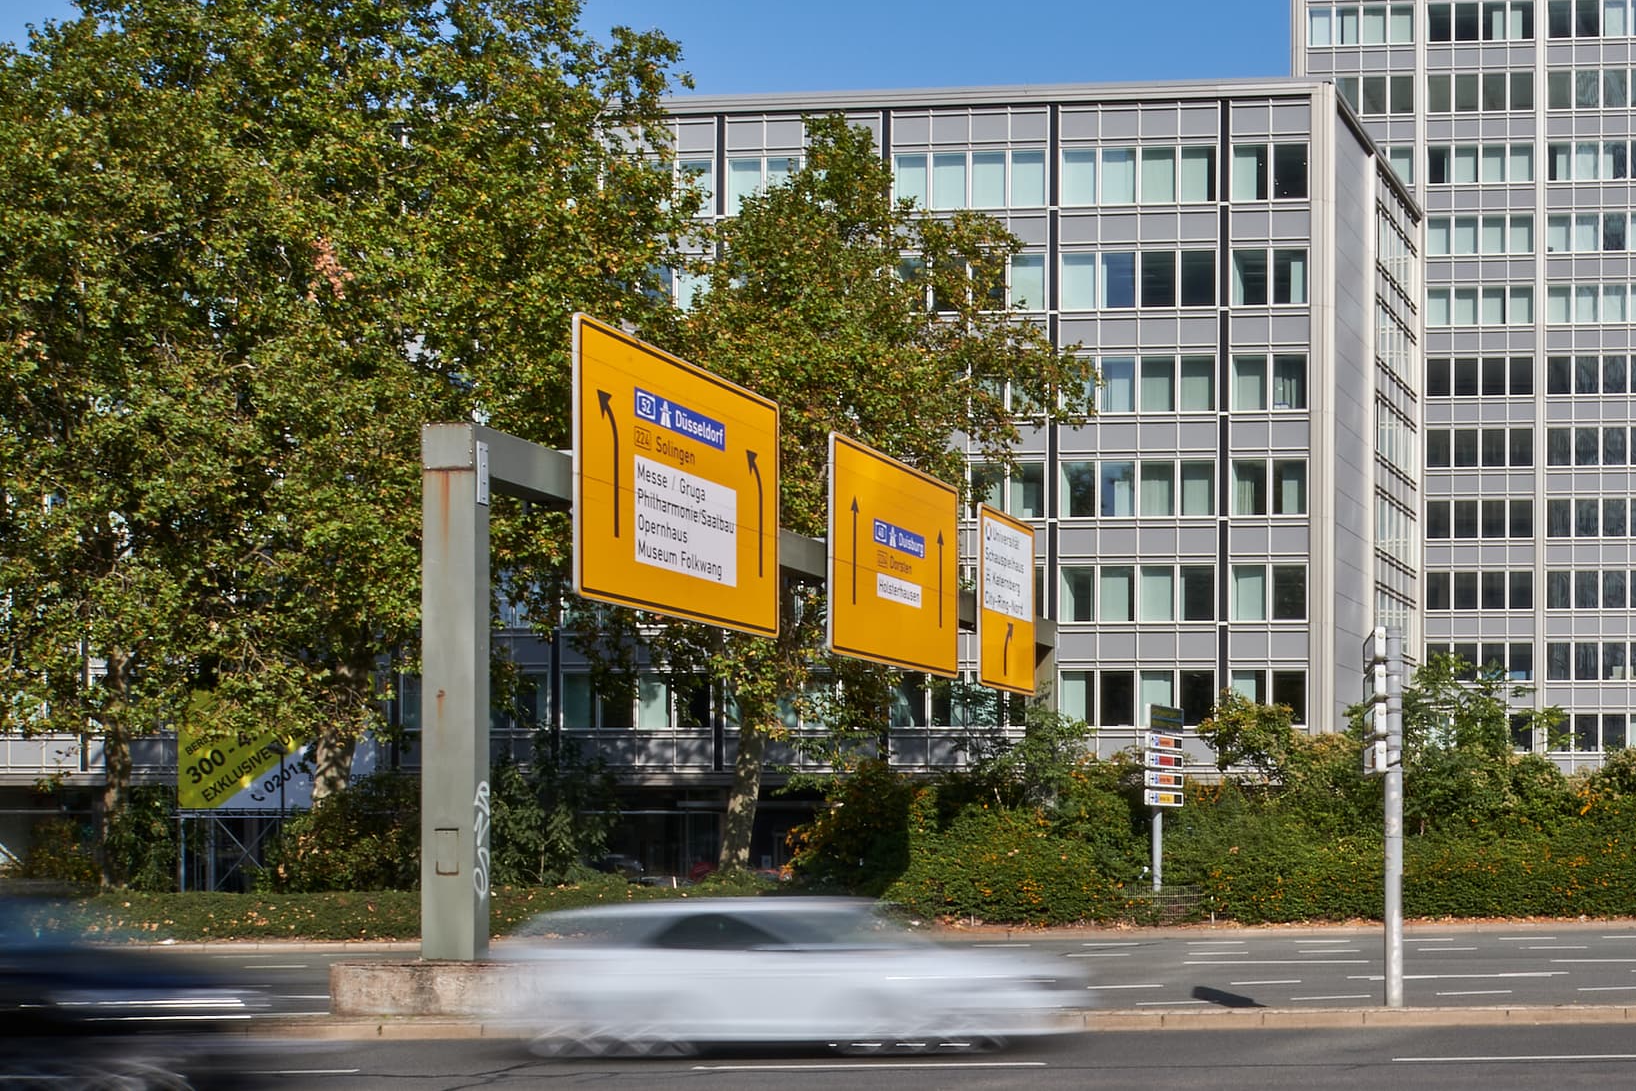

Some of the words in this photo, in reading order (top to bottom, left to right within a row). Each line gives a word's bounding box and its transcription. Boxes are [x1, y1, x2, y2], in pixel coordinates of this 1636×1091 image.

[641, 398, 652, 414] 52
[675, 410, 724, 446] Düsseldorf
[635, 429, 650, 446] 224
[656, 435, 696, 466] Solingen
[637, 461, 668, 489] Messe
[679, 477, 706, 504] Gruga
[637, 487, 735, 534] Philharmonie/Saalbau
[638, 513, 688, 544] Opernhaus
[638, 538, 678, 566] Museum
[681, 550, 722, 581] Folkwang
[898, 532, 924, 558] Duisburg
[186, 749, 226, 785] 300
[201, 746, 273, 803] EXKLUSIVE
[263, 763, 300, 794] 0201
